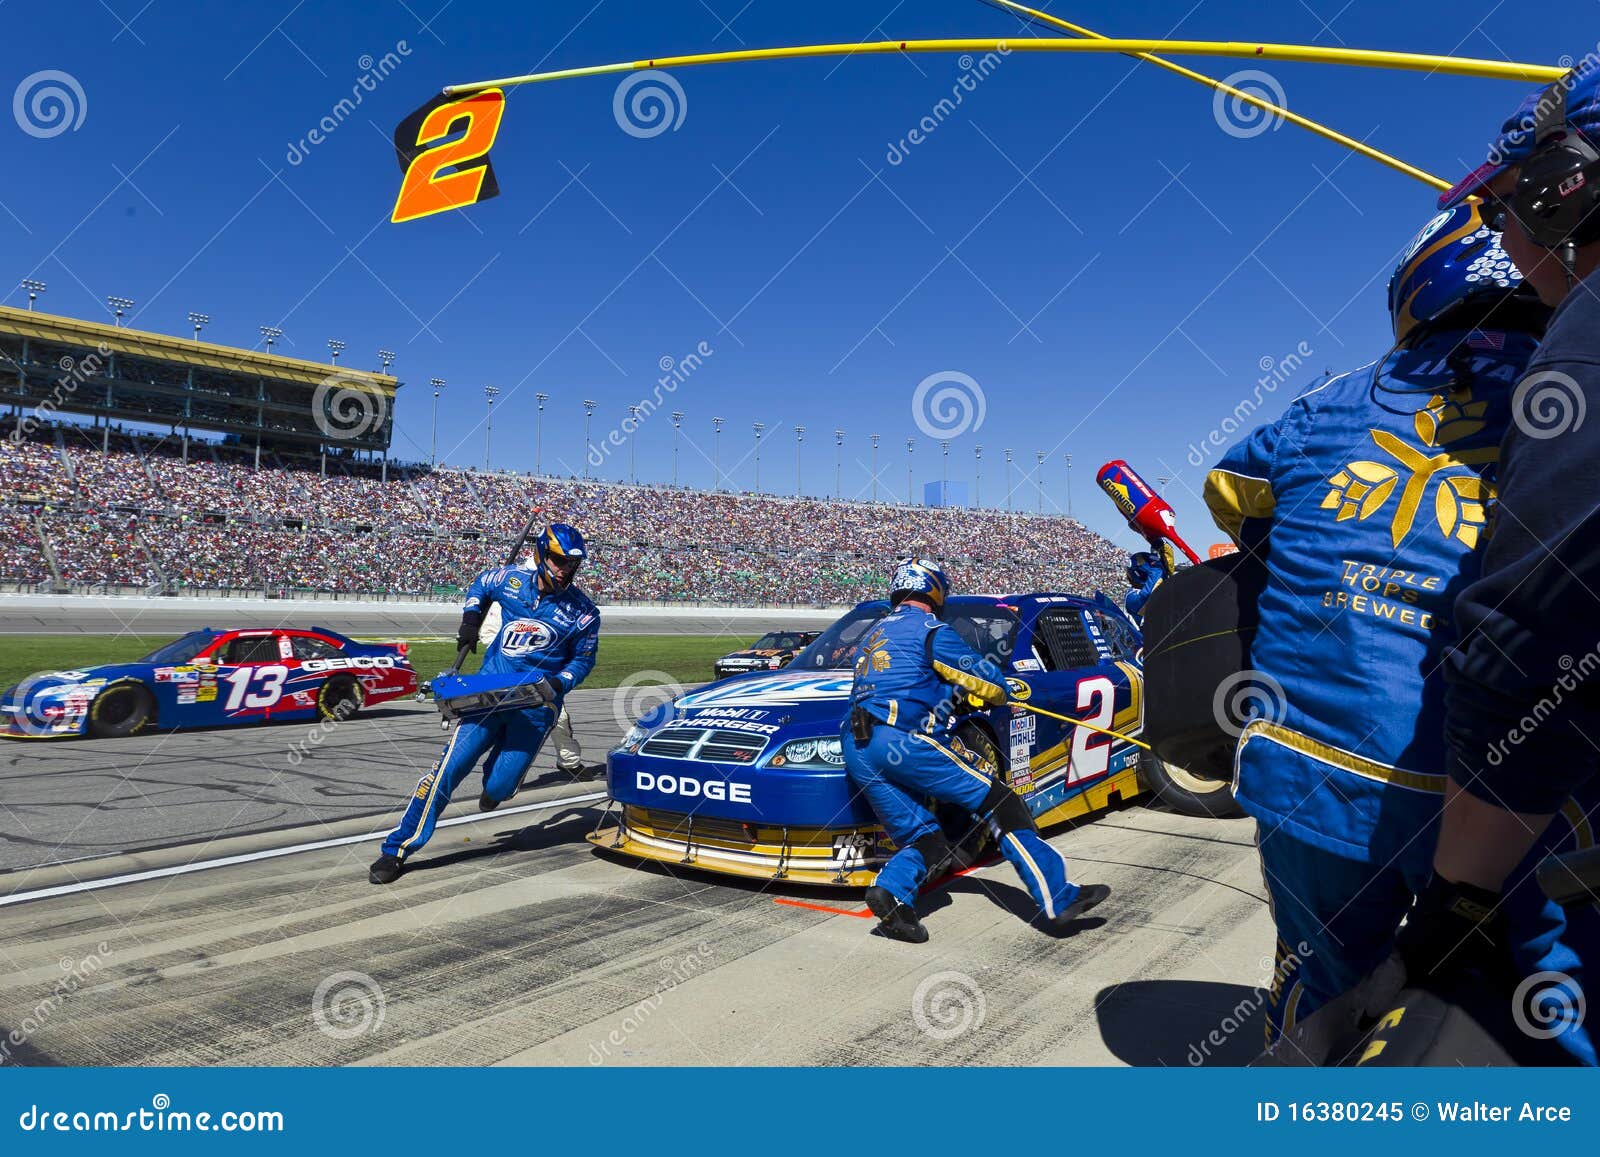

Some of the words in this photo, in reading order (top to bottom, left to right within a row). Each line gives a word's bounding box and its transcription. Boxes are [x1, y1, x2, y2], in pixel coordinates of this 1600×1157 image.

[390, 88, 504, 222] 2
[1103, 479, 1136, 514] SUNOCO
[1341, 572, 1419, 603] HOPS
[1342, 560, 1441, 590] TRIPLE
[1321, 592, 1438, 630] BREWED
[513, 623, 540, 633] Miller
[301, 656, 394, 672] GEICO
[224, 664, 289, 711] 13
[664, 718, 780, 734] CHARGER
[695, 707, 750, 719] Mobil
[1011, 718, 1027, 731] Mobil
[1028, 716, 1035, 728] 1
[1011, 731, 1036, 747] MAHLE
[1065, 675, 1116, 788] 2
[1011, 754, 1030, 766] TISSOT
[636, 771, 752, 804] DODGE
